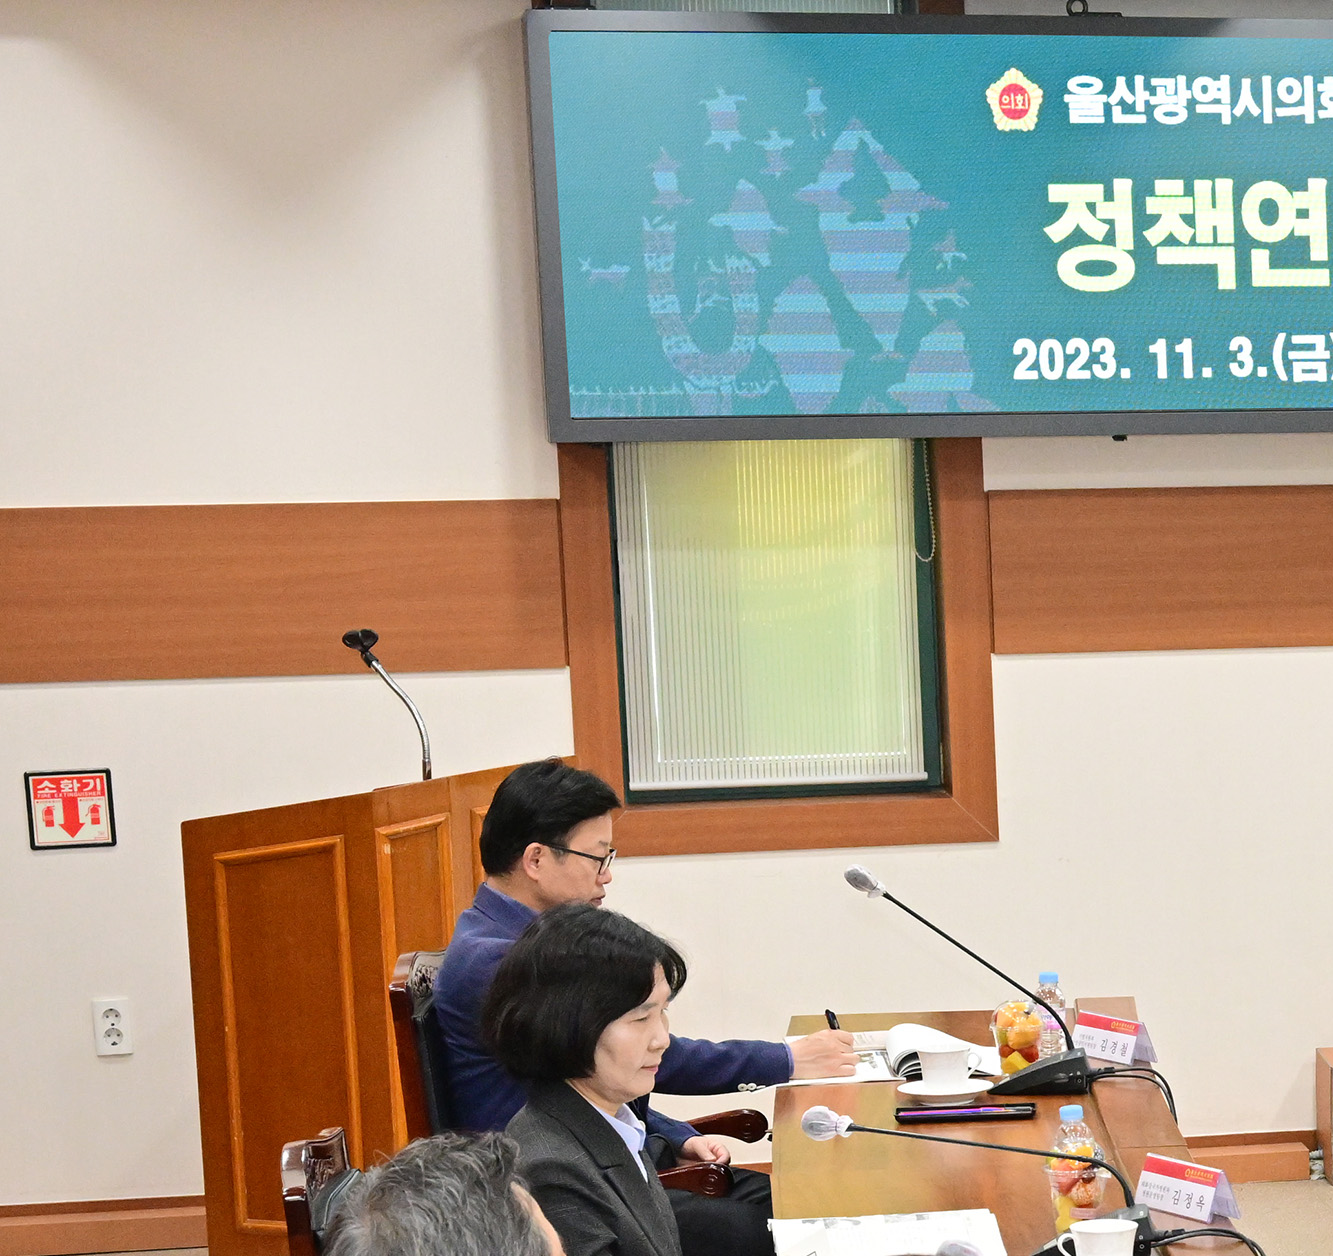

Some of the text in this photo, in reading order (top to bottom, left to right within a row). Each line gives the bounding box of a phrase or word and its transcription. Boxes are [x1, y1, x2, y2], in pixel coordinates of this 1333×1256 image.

[1000, 92, 1029, 110] 의회
[1013, 337, 1132, 381] 2023.
[1149, 338, 1213, 380] 11.
[37, 778, 101, 794] 소화기
[1171, 1189, 1205, 1212] 김정옥
